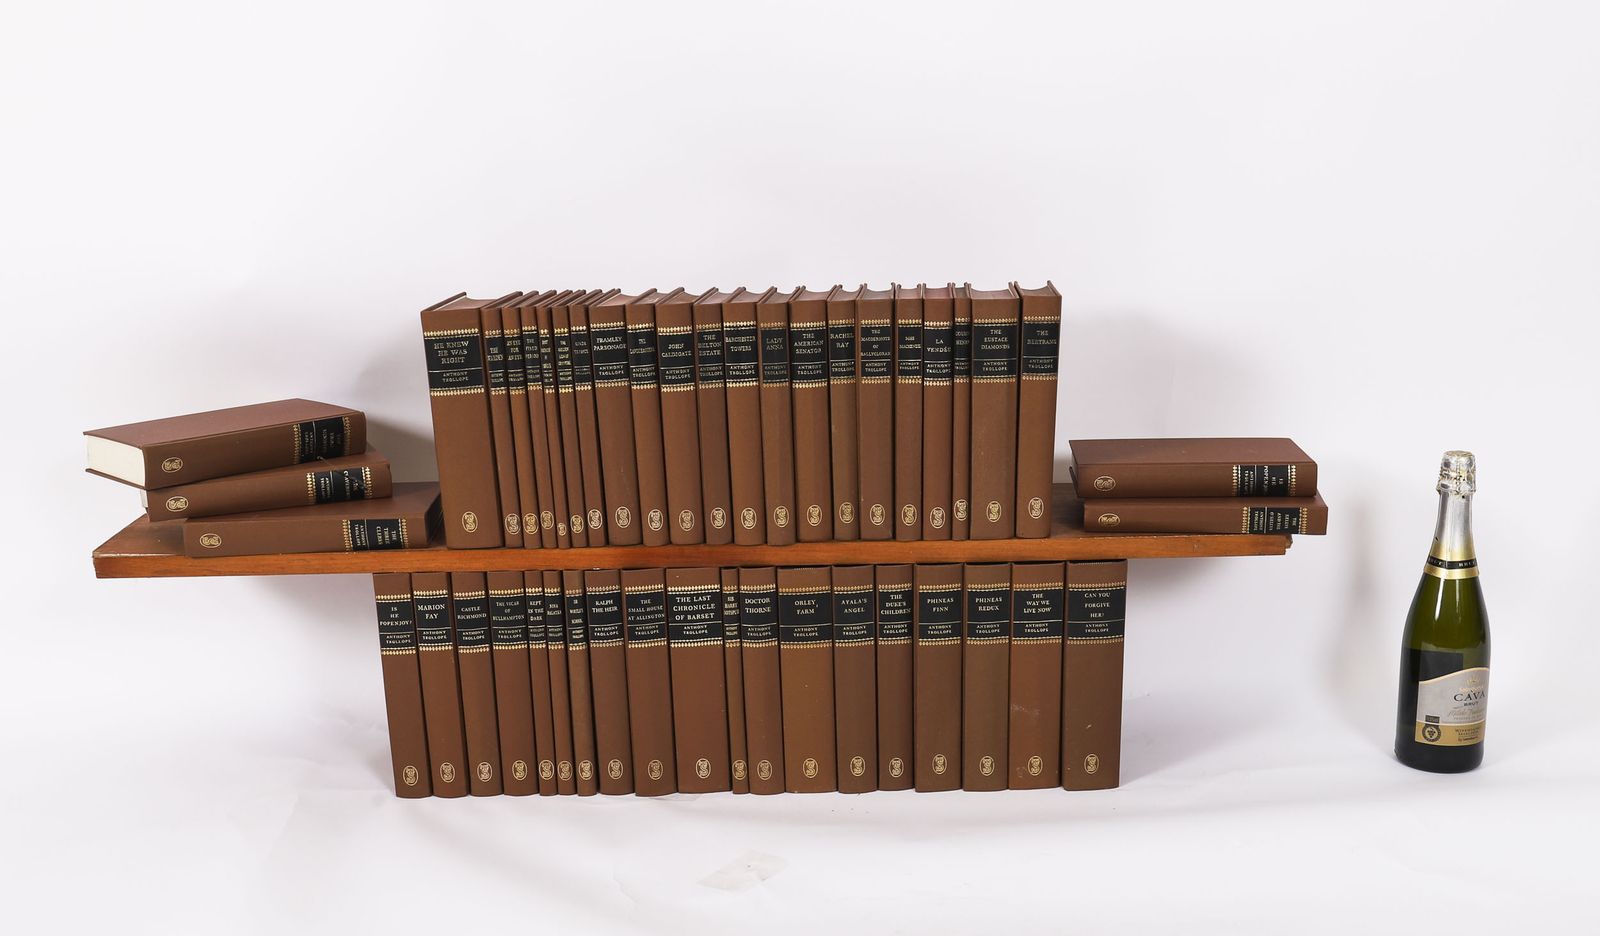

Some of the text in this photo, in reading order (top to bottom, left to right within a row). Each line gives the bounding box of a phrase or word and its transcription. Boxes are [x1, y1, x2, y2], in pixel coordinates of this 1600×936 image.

[446, 341, 469, 349] KNEW
[673, 603, 715, 612] CHRONICLE
[675, 612, 715, 621] OF BARSET
[1453, 690, 1486, 702] CAVA
